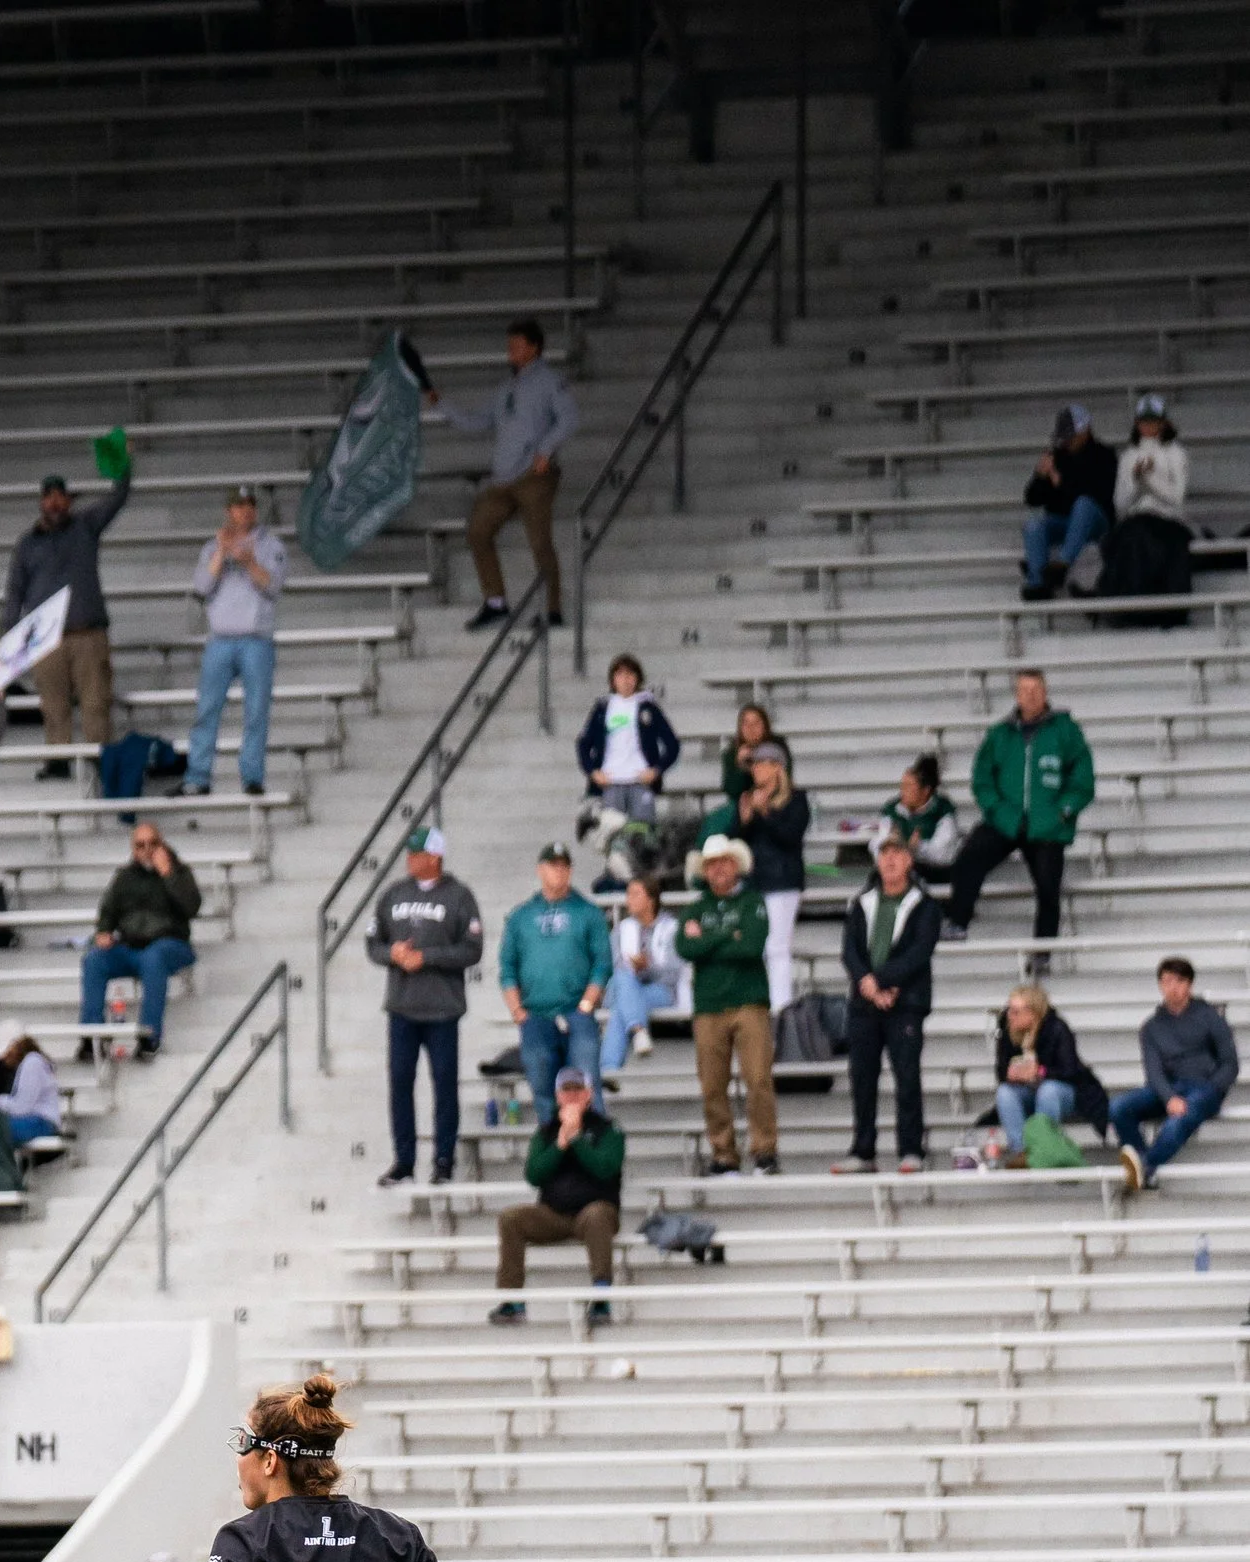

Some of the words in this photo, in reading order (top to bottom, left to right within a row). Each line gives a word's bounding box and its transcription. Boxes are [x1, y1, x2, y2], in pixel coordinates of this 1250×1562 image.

[234, 1306, 248, 1324] 12
[16, 1433, 56, 1462] NH
[299, 1448, 323, 1457] GAIT
[325, 1537, 336, 1546] NO
[337, 1535, 356, 1546] DOG
